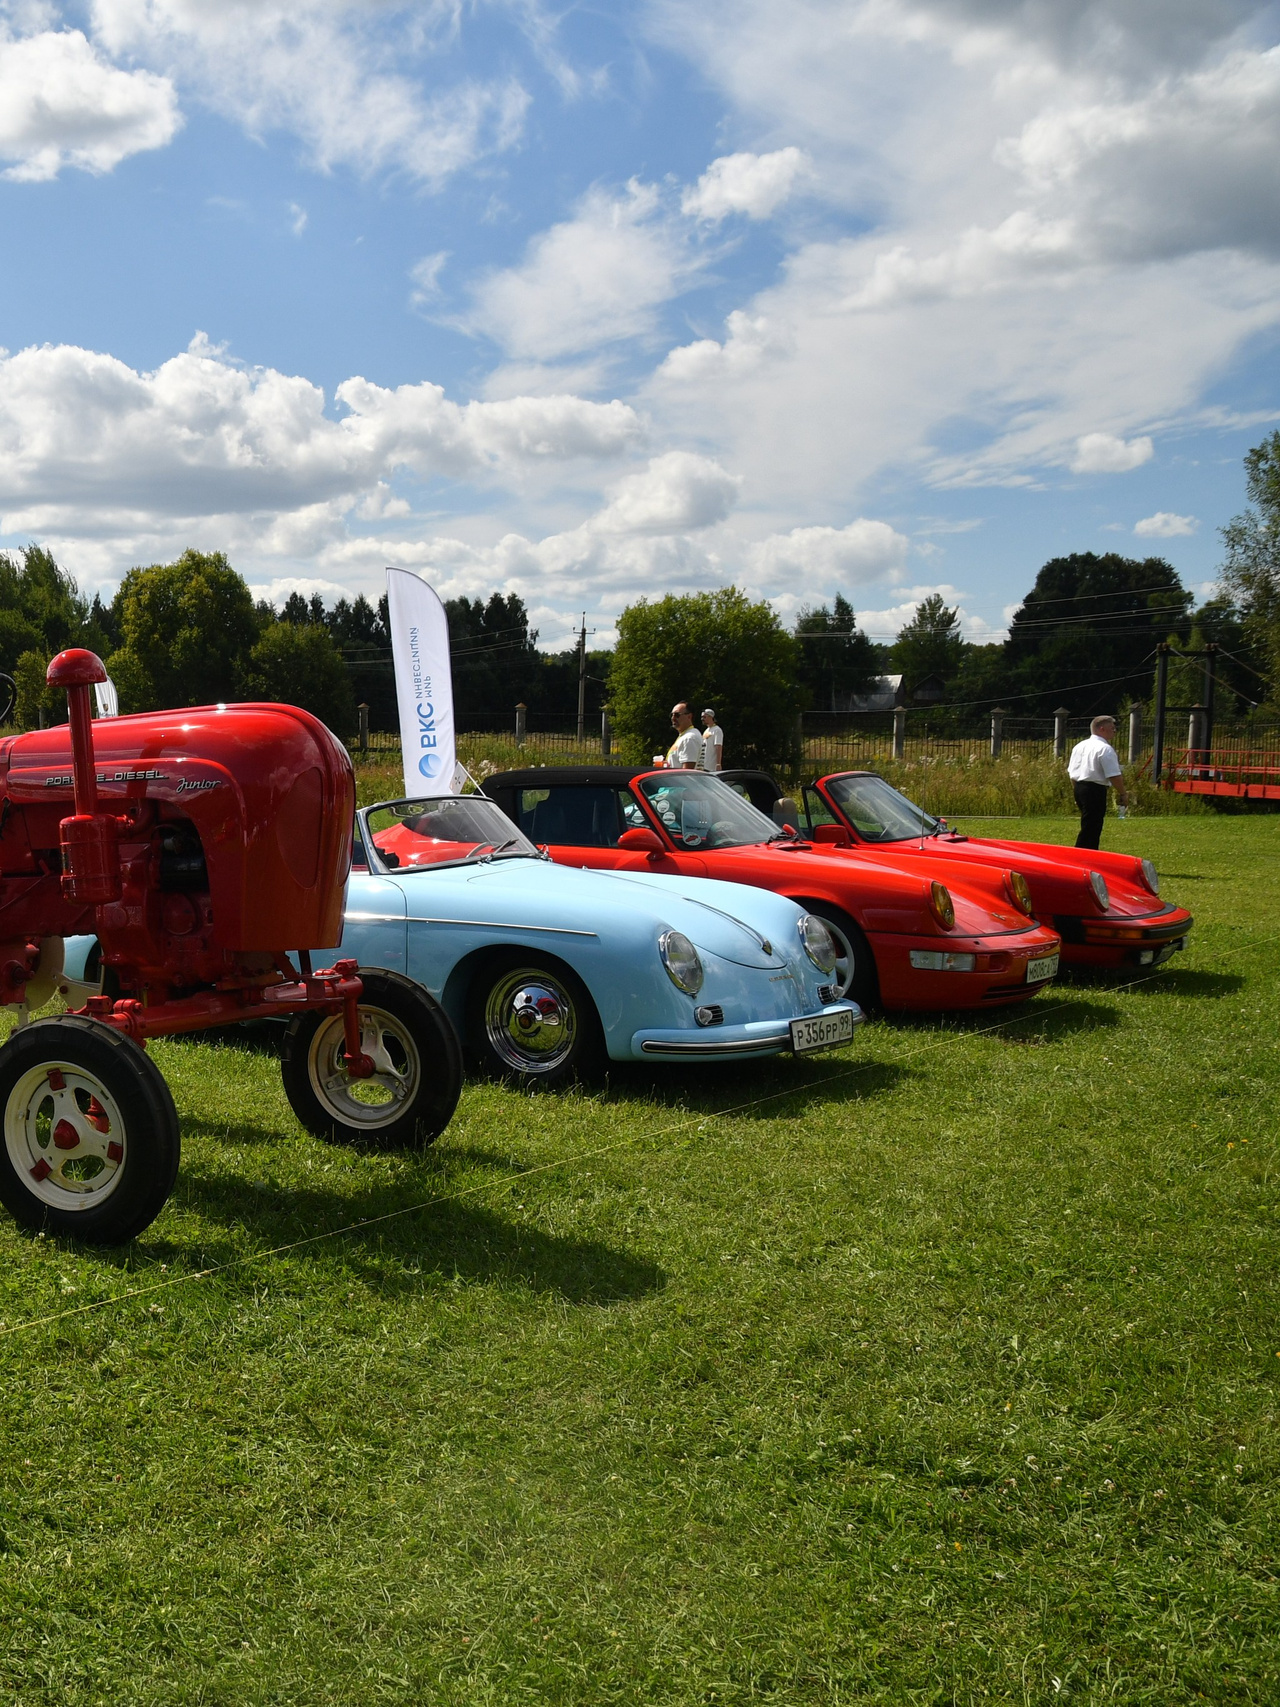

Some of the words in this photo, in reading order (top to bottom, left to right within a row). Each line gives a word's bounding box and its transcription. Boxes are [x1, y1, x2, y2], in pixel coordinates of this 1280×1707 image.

[176, 778, 221, 793] Junior
[797, 1020, 838, 1047] P356PP
[840, 1014, 849, 1031] 99
